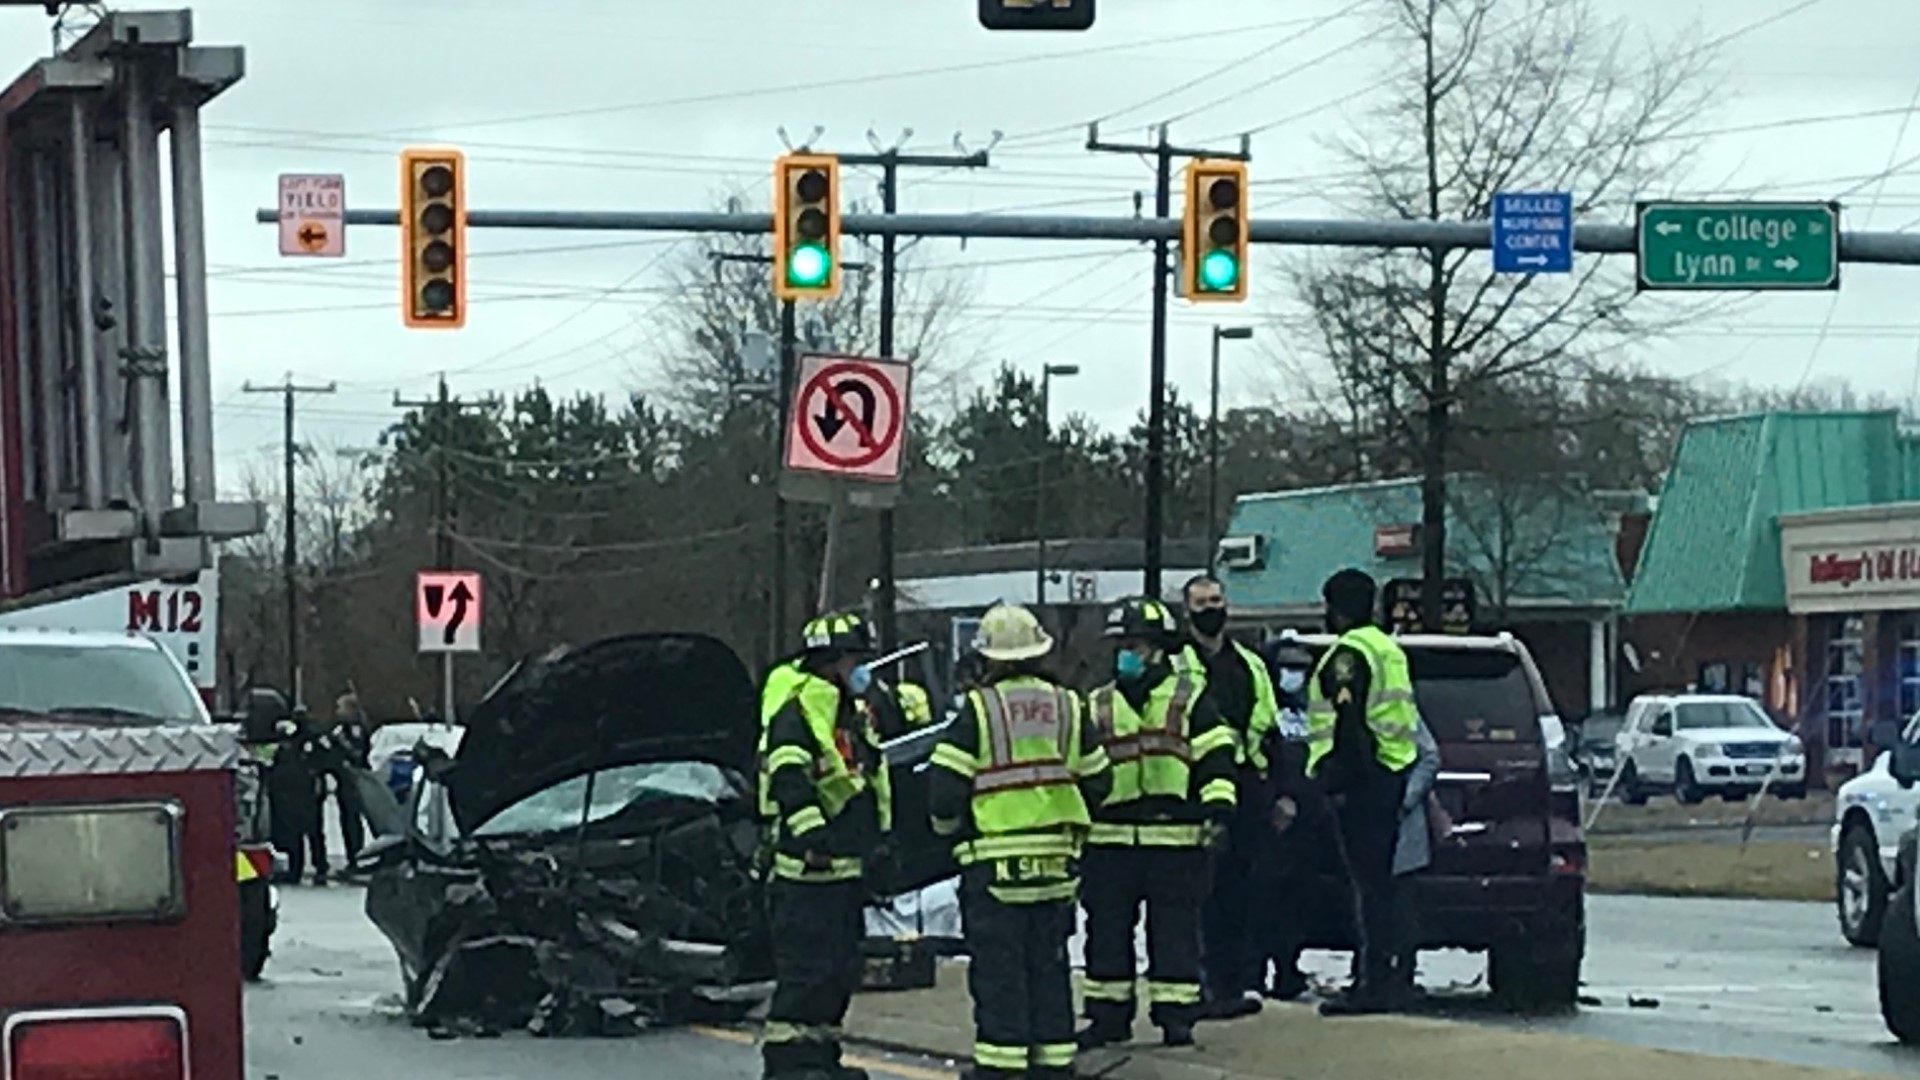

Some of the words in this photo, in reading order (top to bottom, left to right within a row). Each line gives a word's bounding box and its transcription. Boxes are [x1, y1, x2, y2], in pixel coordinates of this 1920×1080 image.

[1697, 214, 1797, 248] College
[1675, 252, 1735, 283] Lynn
[126, 590, 202, 633] M12
[1009, 701, 1056, 724] FIRE
